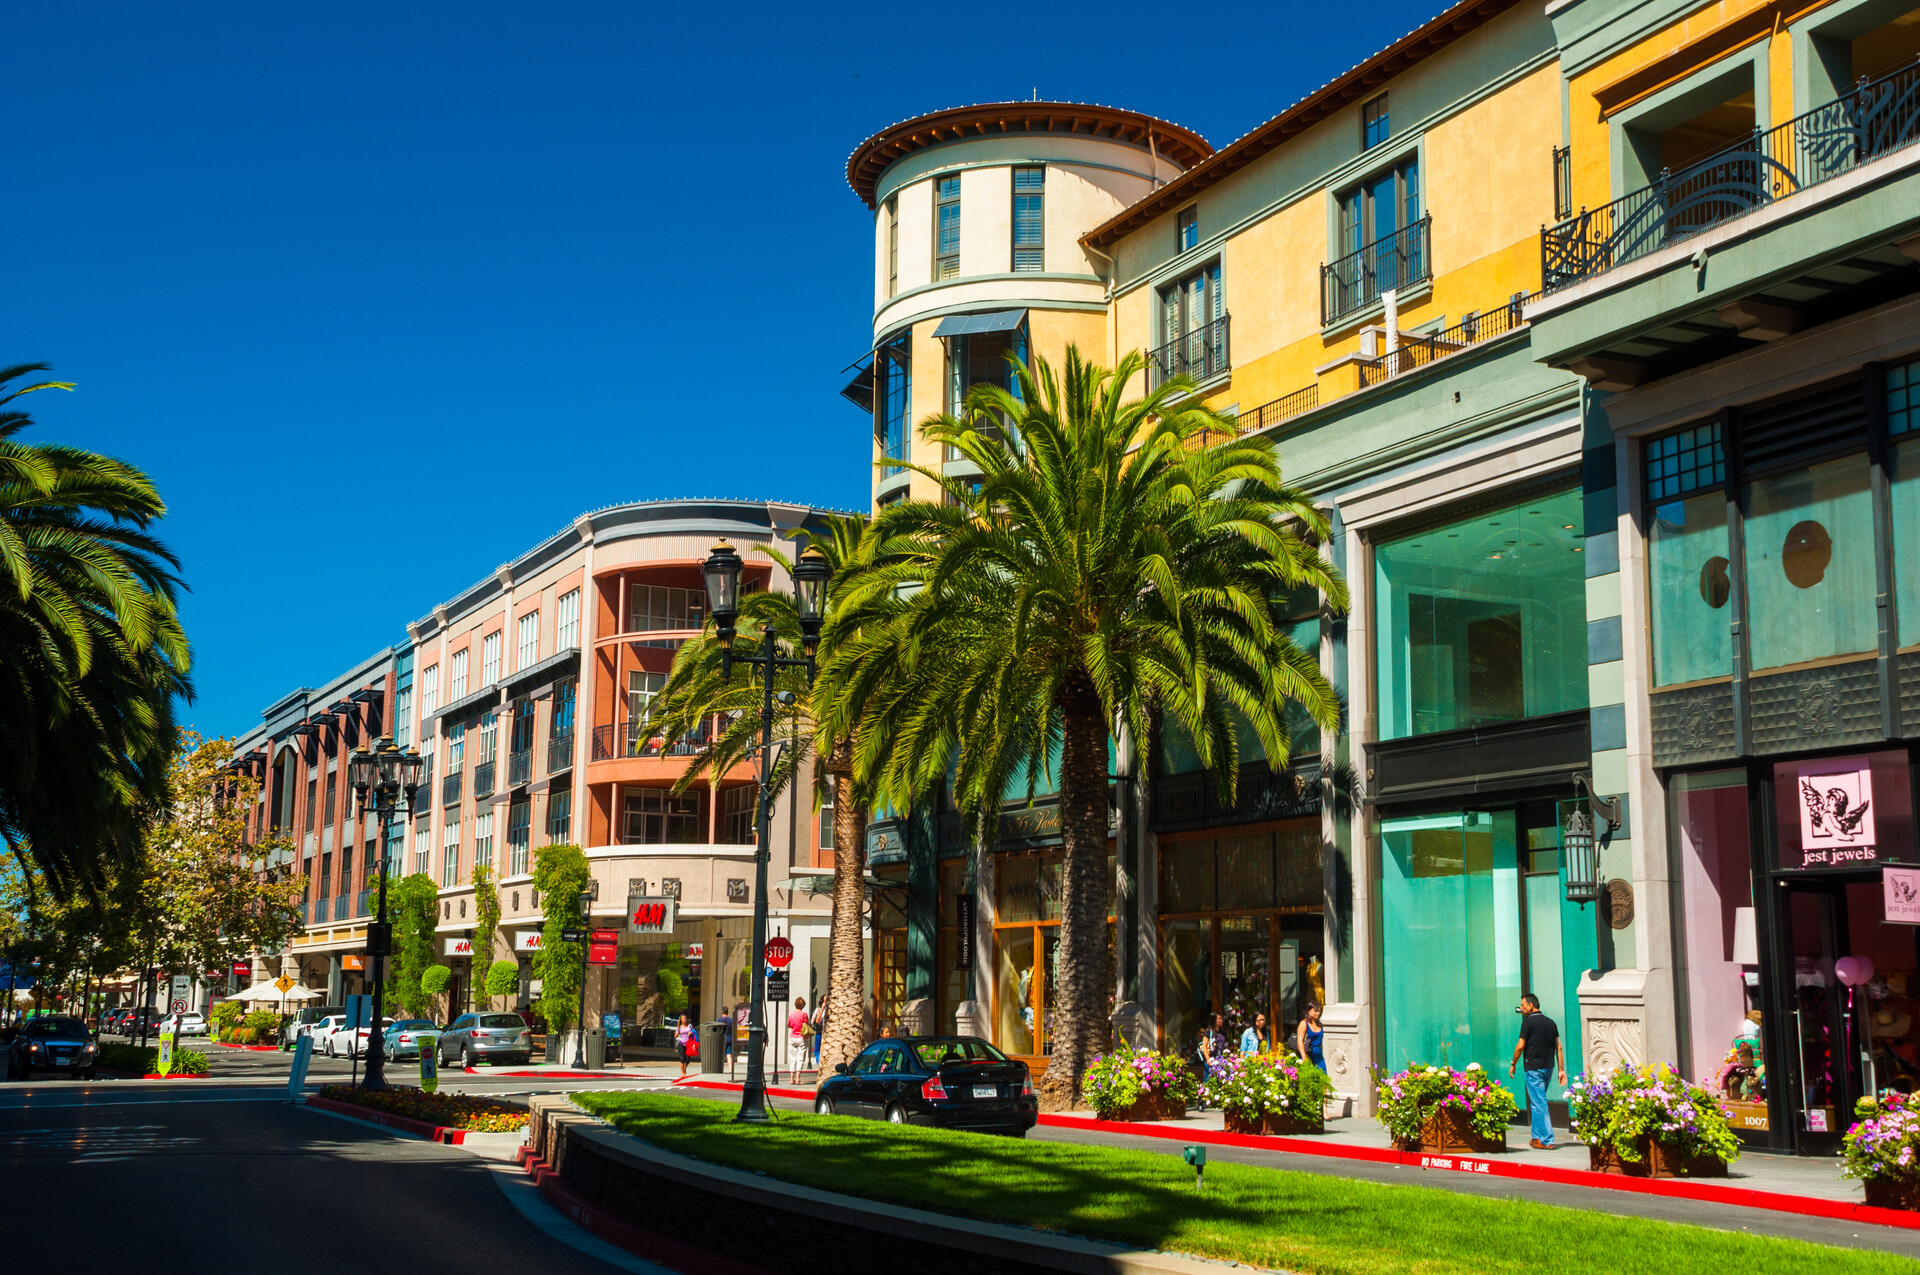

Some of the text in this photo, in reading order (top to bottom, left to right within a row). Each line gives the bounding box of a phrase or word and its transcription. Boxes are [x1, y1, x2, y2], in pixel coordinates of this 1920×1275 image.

[1802, 846, 1876, 866] jest jewels
[633, 903, 665, 926] H&M
[1901, 905, 1920, 914] jewel
[455, 942, 471, 953] H&M
[767, 946, 792, 958] STOP
[1744, 1116, 1767, 1128] 1007
[1421, 1157, 1490, 1173] NO PARKING FIRE LANE
